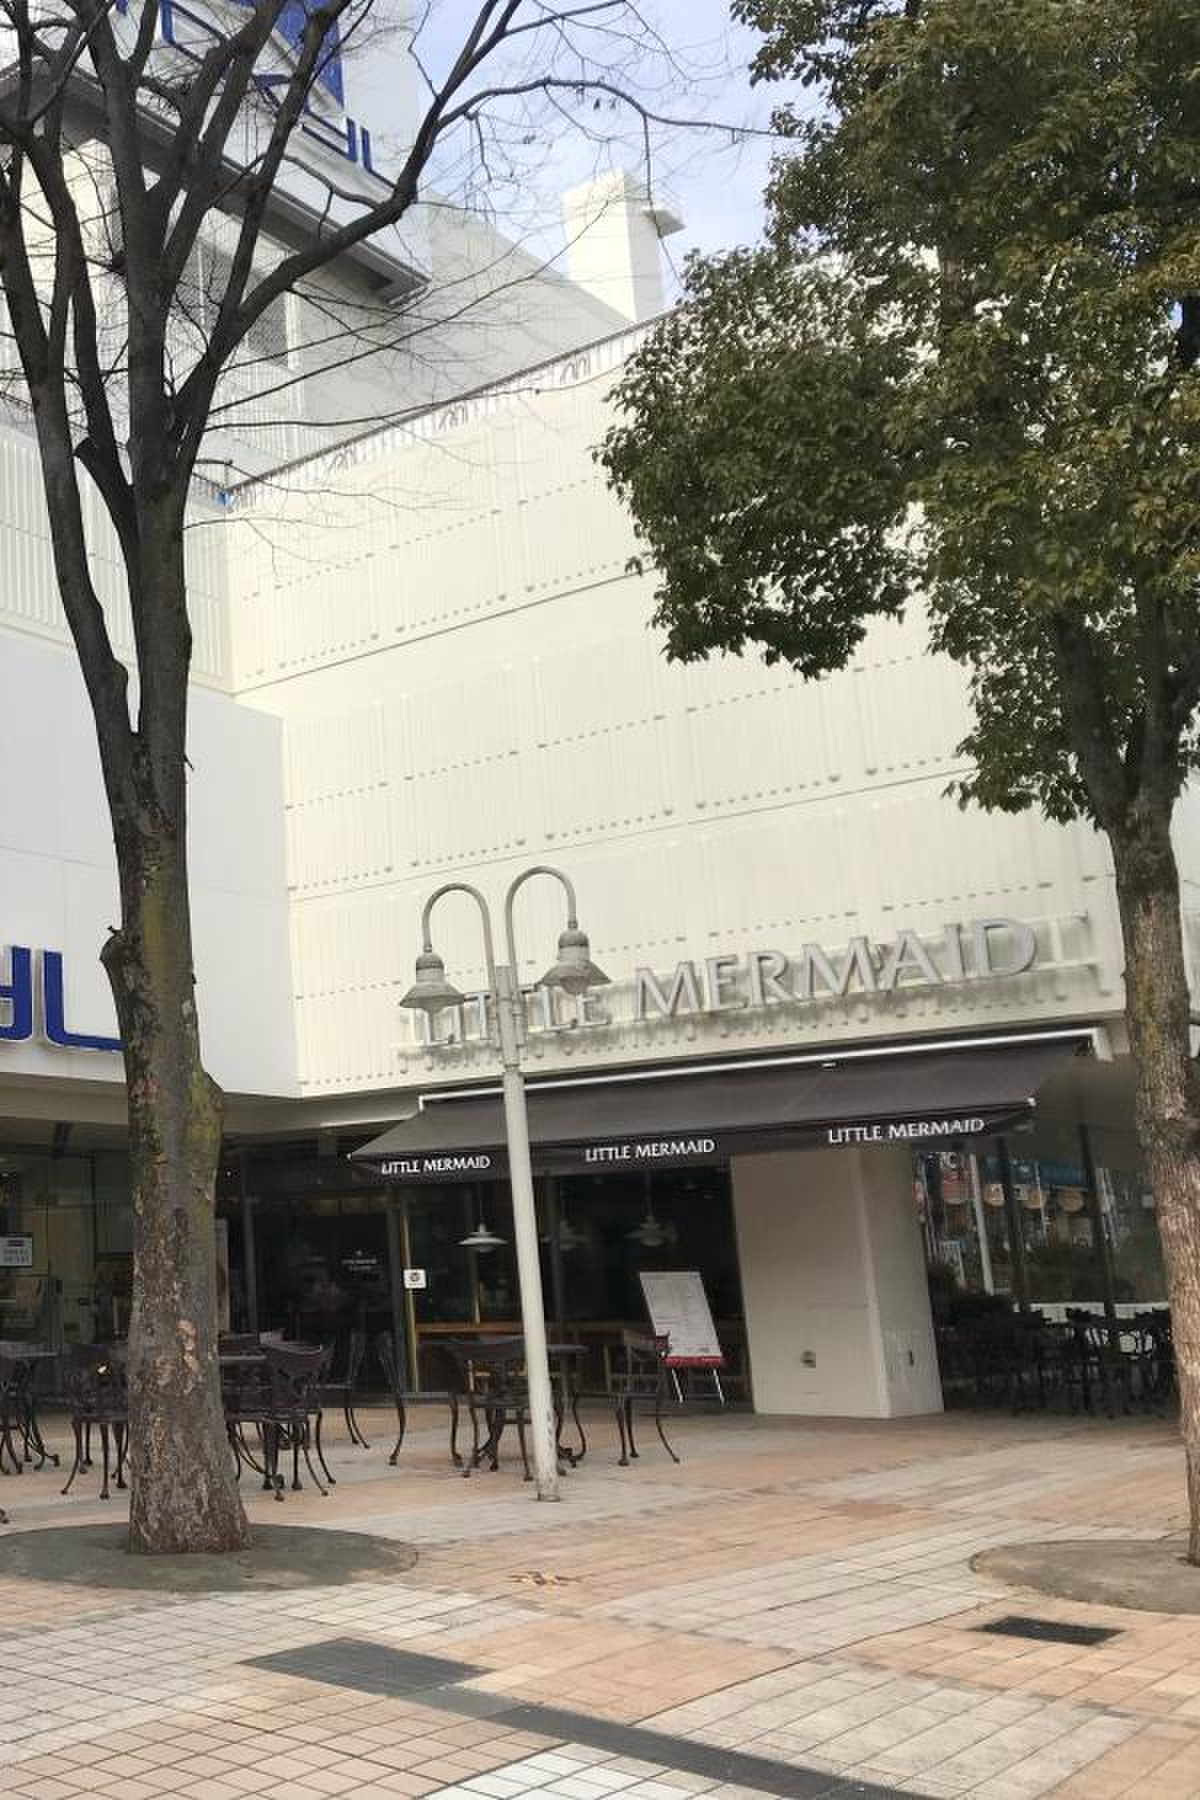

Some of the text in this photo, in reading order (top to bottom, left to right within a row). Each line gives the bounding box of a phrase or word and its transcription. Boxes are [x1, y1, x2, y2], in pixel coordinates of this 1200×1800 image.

[634, 917, 1038, 1023] MERMAID
[828, 1117, 985, 1144] LITTLE MERMAID
[585, 1138, 715, 1163] LITTLE MERMAID
[381, 1154, 491, 1175] LITTLE MERMAID
